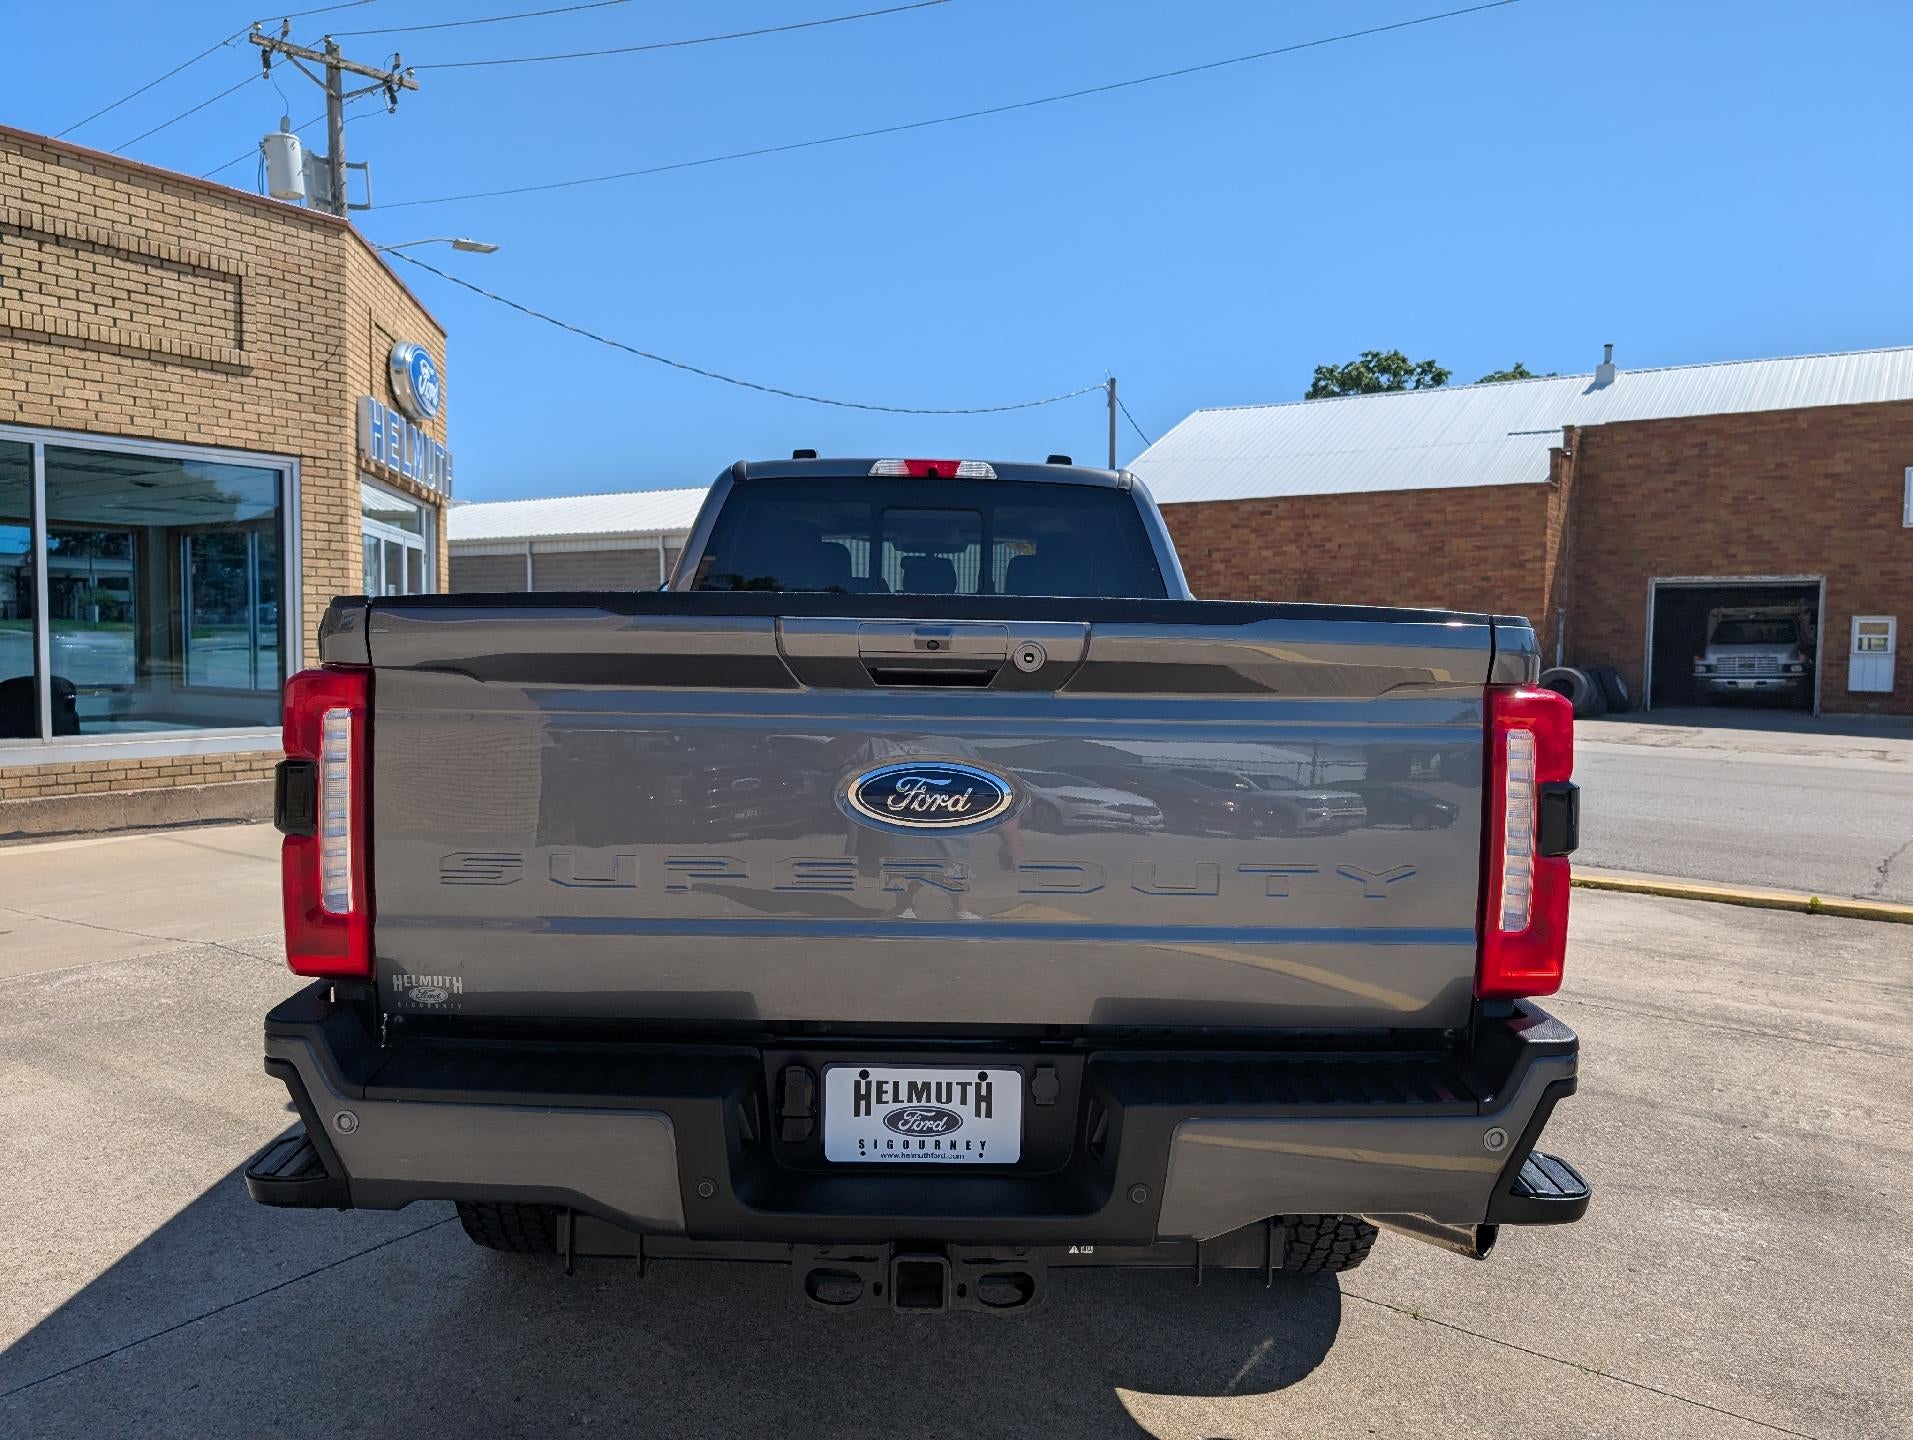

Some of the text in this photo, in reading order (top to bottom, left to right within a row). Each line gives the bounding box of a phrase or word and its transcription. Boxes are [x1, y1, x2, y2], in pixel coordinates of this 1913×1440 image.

[417, 358, 439, 406] Ford
[358, 395, 453, 500] HELMUTH
[888, 776, 973, 811] Ford
[439, 852, 1418, 898] SUPER DUTY
[392, 974, 463, 994] HELMUTH
[853, 1079, 993, 1119] HELMUTH
[898, 1111, 947, 1131] Ford
[858, 1138, 987, 1151] SIGOURNEY
[880, 1151, 965, 1160] www.helmuthford.com
